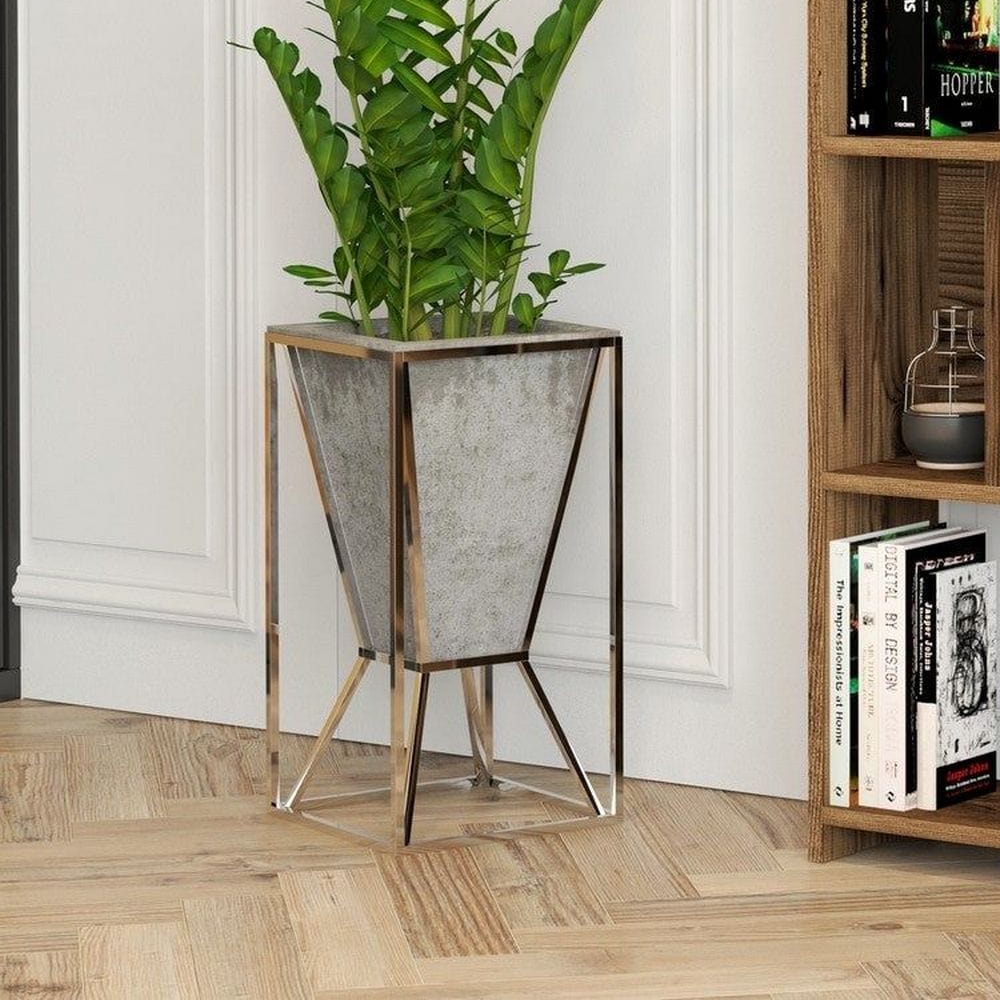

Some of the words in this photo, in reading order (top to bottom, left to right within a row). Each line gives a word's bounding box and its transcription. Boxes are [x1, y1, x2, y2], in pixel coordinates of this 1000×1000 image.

[941, 72, 995, 97] HOPPER
[901, 95, 909, 112] 1
[835, 579, 845, 601] The
[884, 545, 898, 603] DIGITAL
[884, 612, 898, 630] BY
[924, 601, 933, 638] Jasper
[834, 604, 845, 692] Impressionists
[924, 640, 933, 672] Johns
[884, 638, 898, 692] DESIGN
[835, 695, 845, 708] at
[835, 711, 845, 746] Home
